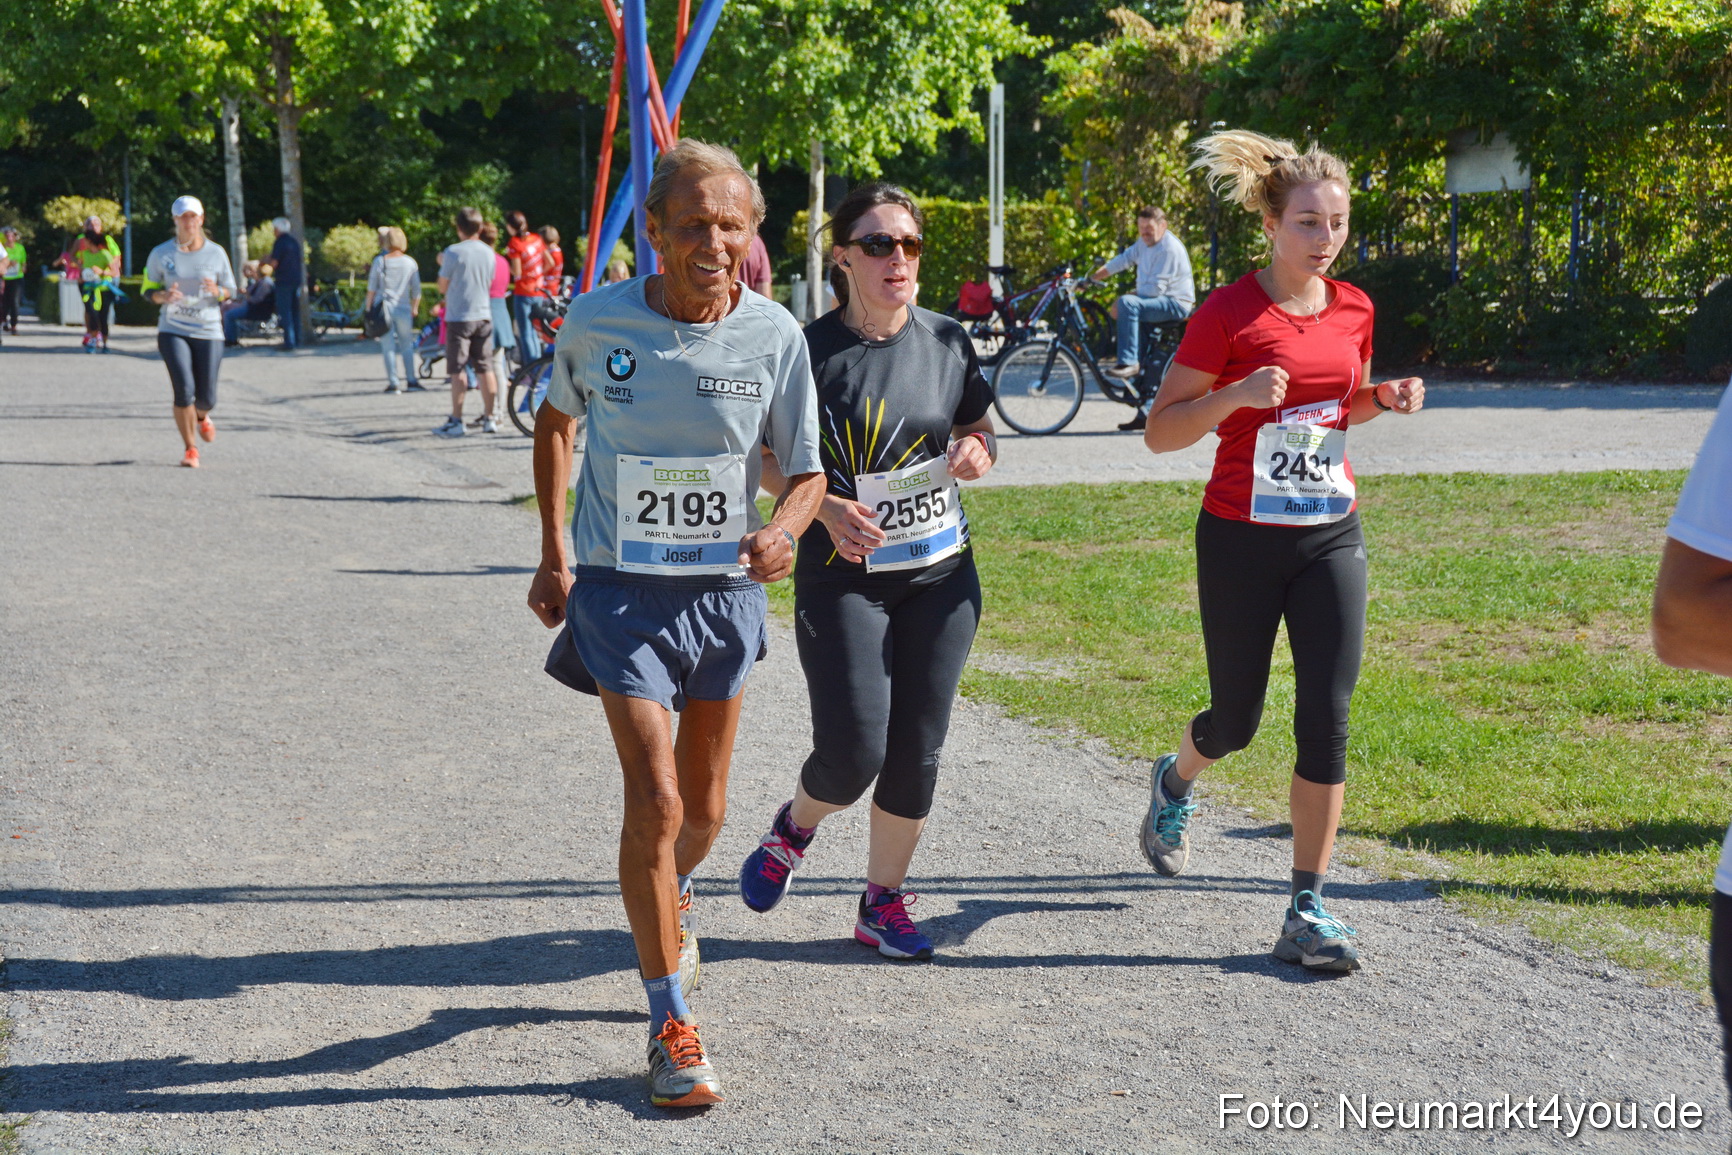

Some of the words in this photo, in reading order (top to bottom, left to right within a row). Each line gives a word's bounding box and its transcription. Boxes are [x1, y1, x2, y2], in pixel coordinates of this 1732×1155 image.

[609, 348, 635, 361] BMW
[604, 385, 634, 398] PARTL
[697, 376, 762, 397] BOCK
[604, 394, 634, 405] Neumarkt
[1297, 408, 1324, 421] DEHN
[1286, 432, 1325, 447] BOCK
[1270, 451, 1335, 482] 2431
[653, 468, 711, 482] BOCK
[888, 471, 931, 491] BOCK
[637, 490, 727, 527] 2193
[876, 486, 947, 532] 2555
[1284, 499, 1325, 513] Annika
[644, 530, 671, 540] PARTL
[672, 531, 710, 540] Neumarkt
[887, 532, 909, 542] PARTL
[910, 525, 937, 537] Neumarkt
[661, 547, 703, 563] Josef
[910, 543, 930, 557] Ute
